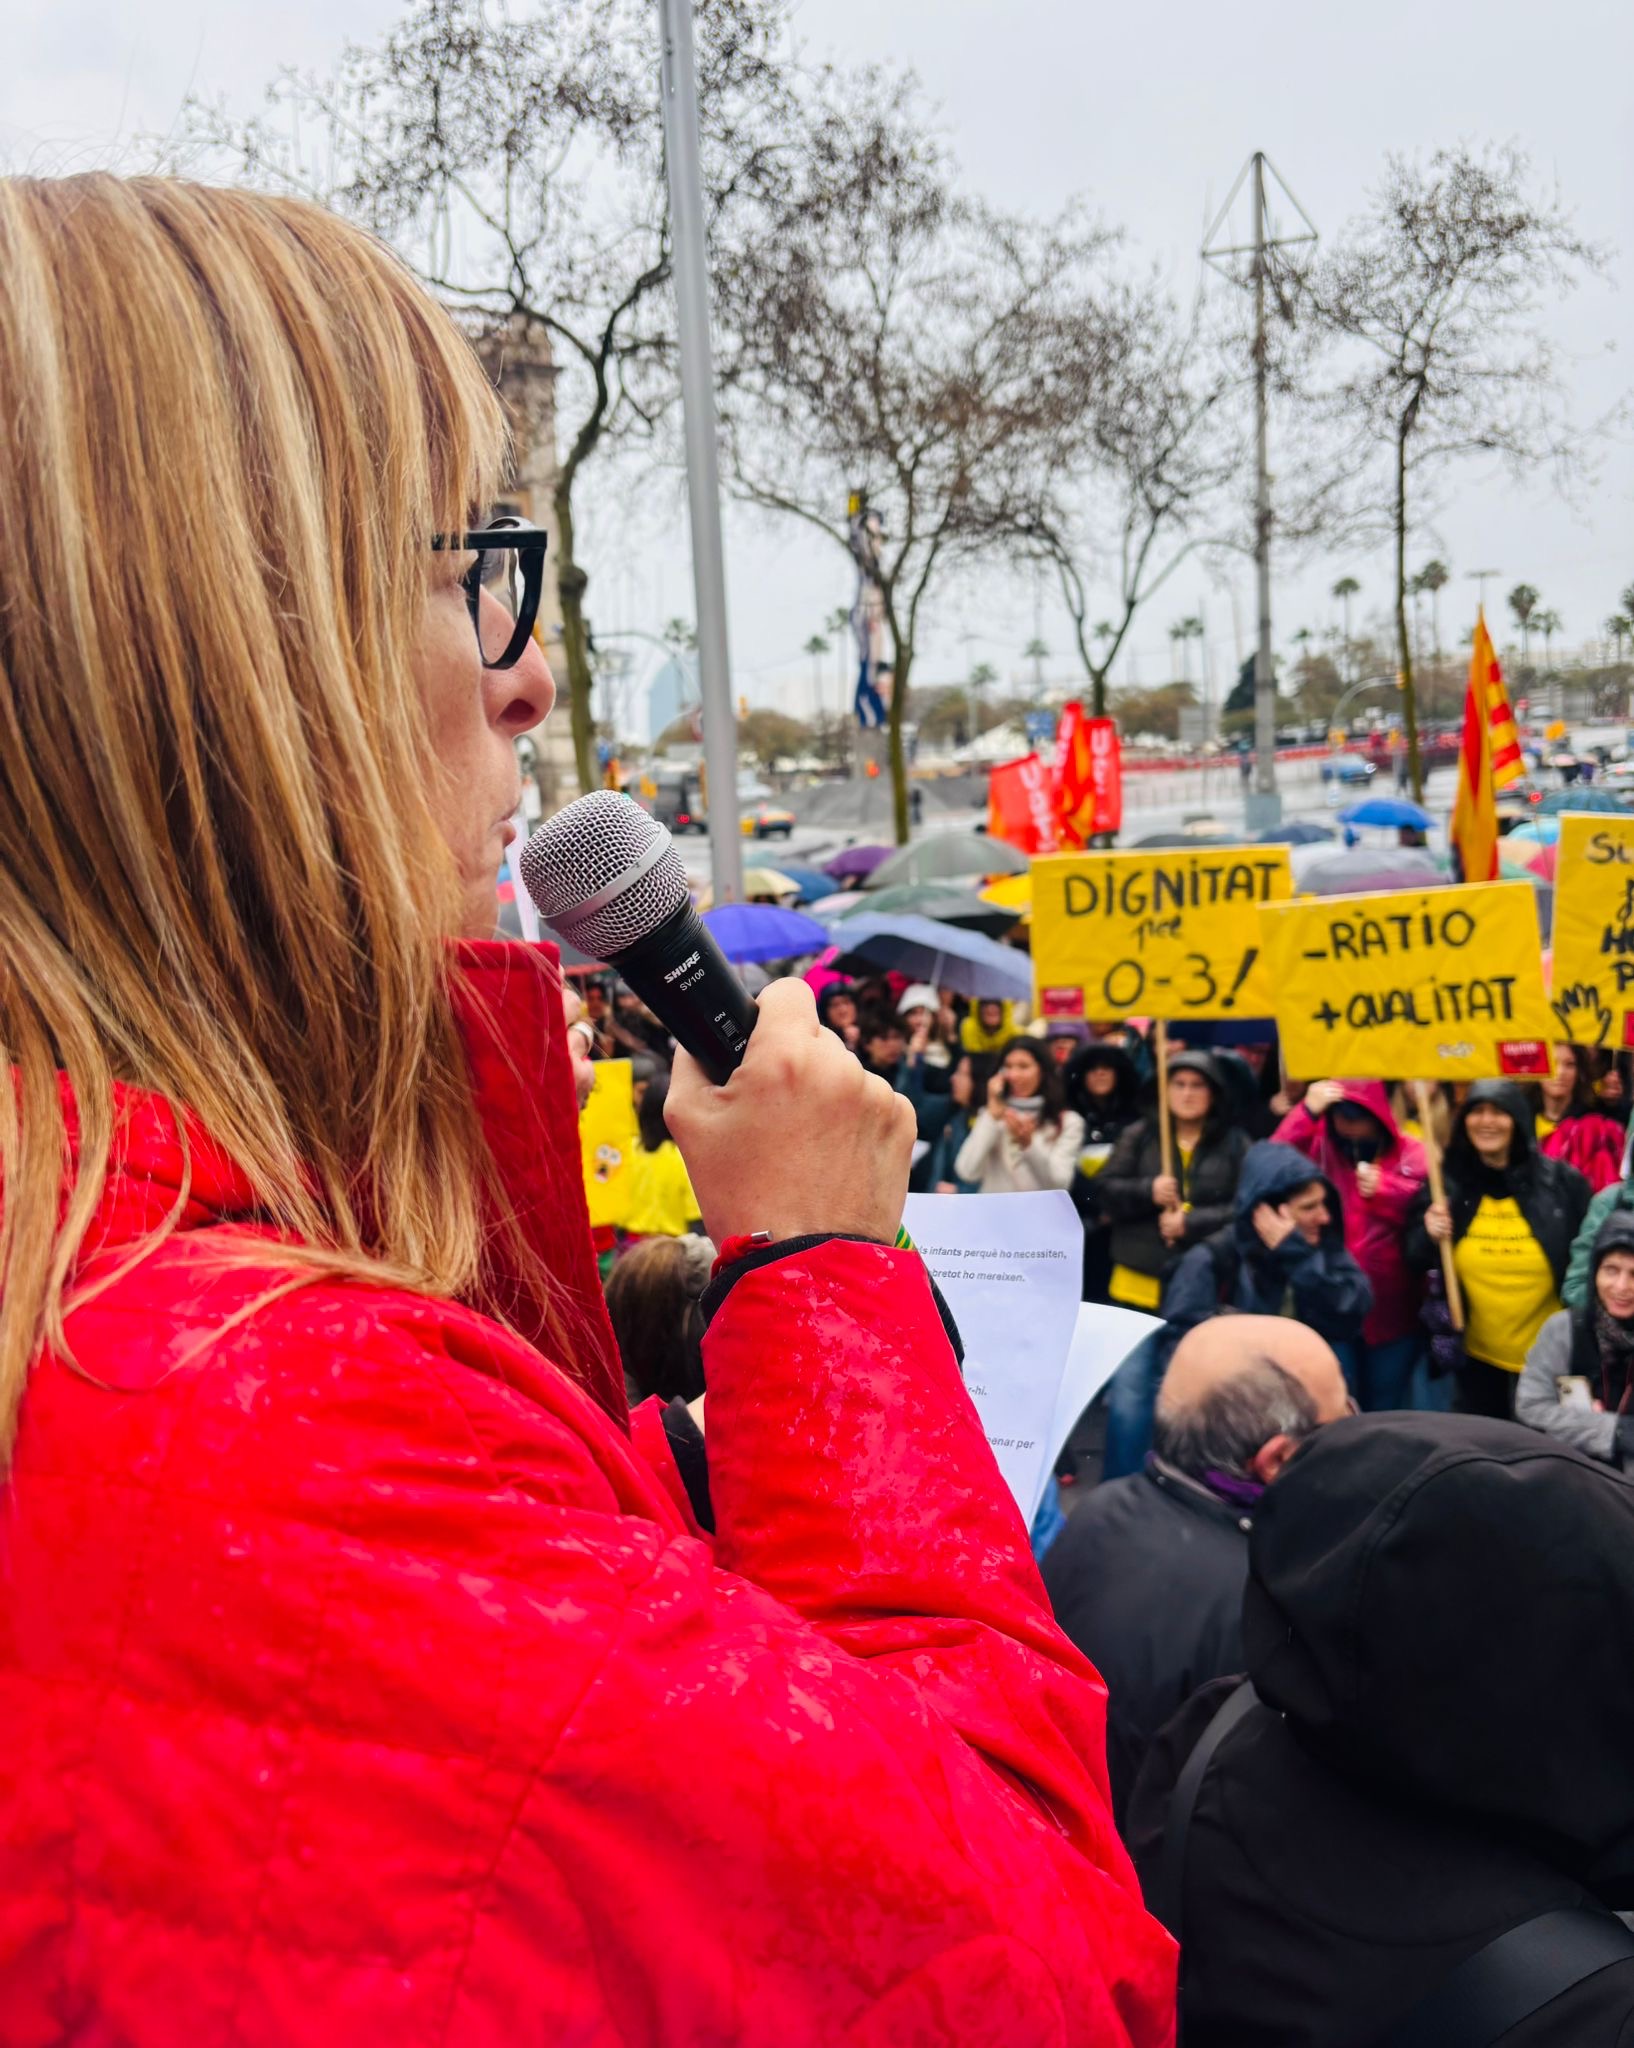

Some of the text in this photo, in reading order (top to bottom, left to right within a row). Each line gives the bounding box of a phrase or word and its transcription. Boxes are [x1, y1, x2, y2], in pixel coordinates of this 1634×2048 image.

[663, 951, 701, 984] SHURE
[679, 968, 706, 991] SV100
[714, 1011, 726, 1022] ON
[734, 1039, 748, 1052] OFF
[929, 1246, 962, 1257] infants
[963, 1248, 998, 1261] perquè
[1000, 1249, 1013, 1259] ho
[1013, 1250, 1067, 1261] necessiten,
[963, 1269, 975, 1280] ho
[976, 1271, 1026, 1283] mereixen.
[1016, 1439, 1036, 1451] per
